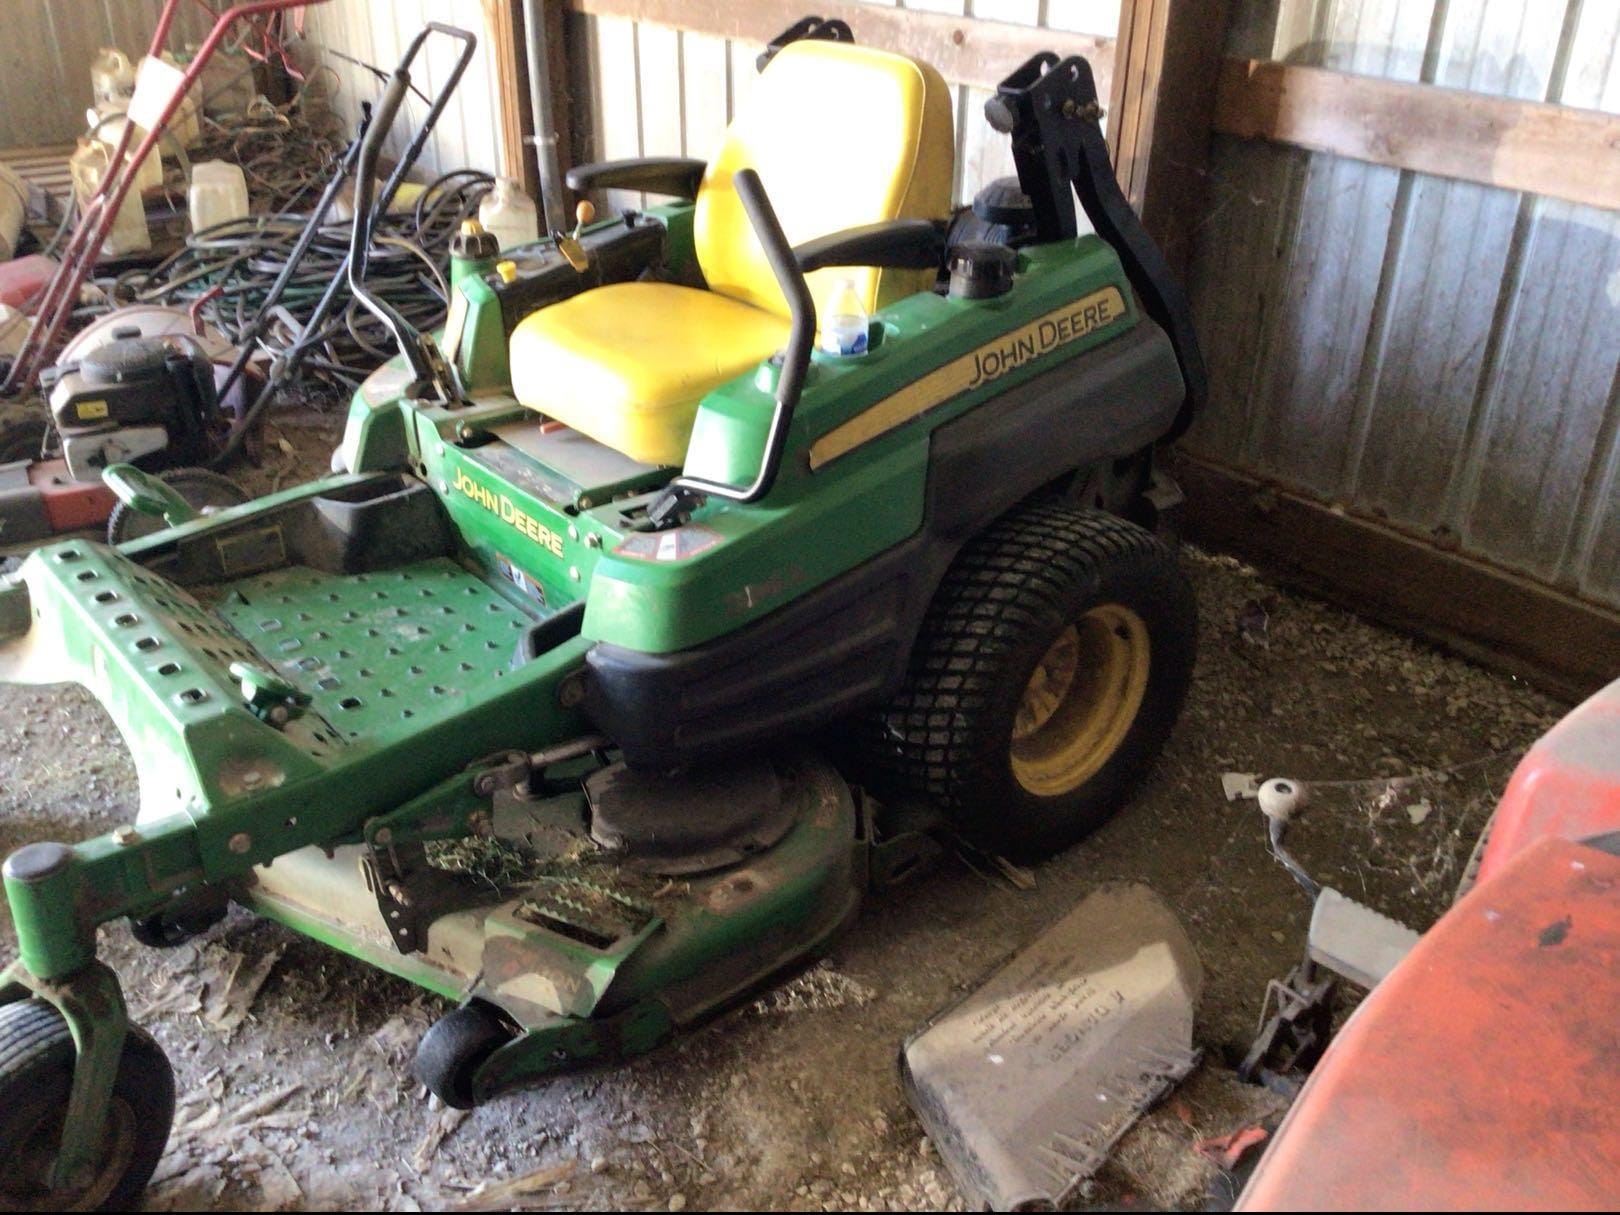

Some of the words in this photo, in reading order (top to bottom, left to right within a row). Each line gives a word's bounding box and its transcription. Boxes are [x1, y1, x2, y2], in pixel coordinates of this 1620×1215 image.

[969, 334, 1035, 386] JOHN
[1038, 299, 1113, 350] DEERE
[452, 467, 499, 516] JOHN
[499, 495, 564, 559] DEERE
